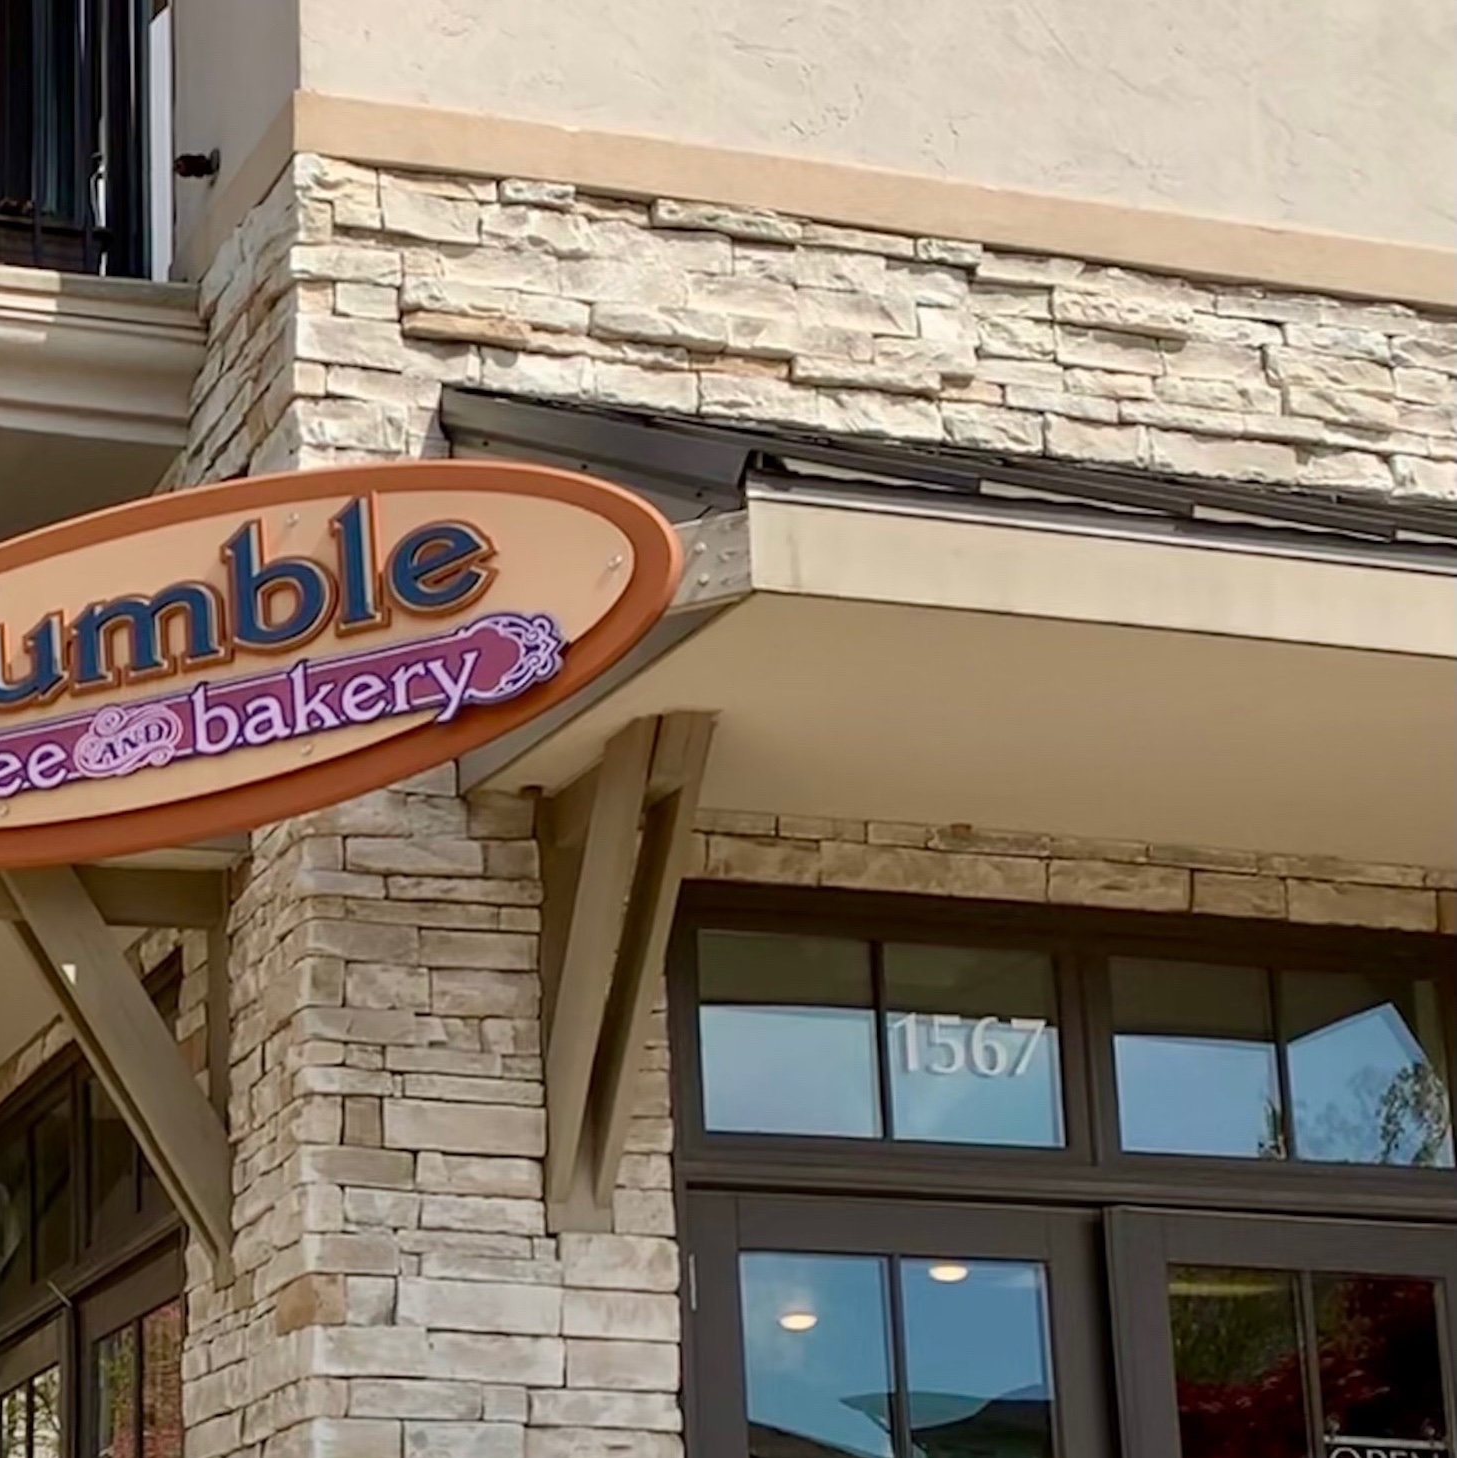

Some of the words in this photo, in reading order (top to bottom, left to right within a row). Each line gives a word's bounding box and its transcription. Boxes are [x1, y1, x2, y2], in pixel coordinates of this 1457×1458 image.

[97, 722, 167, 767] AND
[188, 650, 479, 755] bakery
[892, 1012, 1048, 1077] 1567
